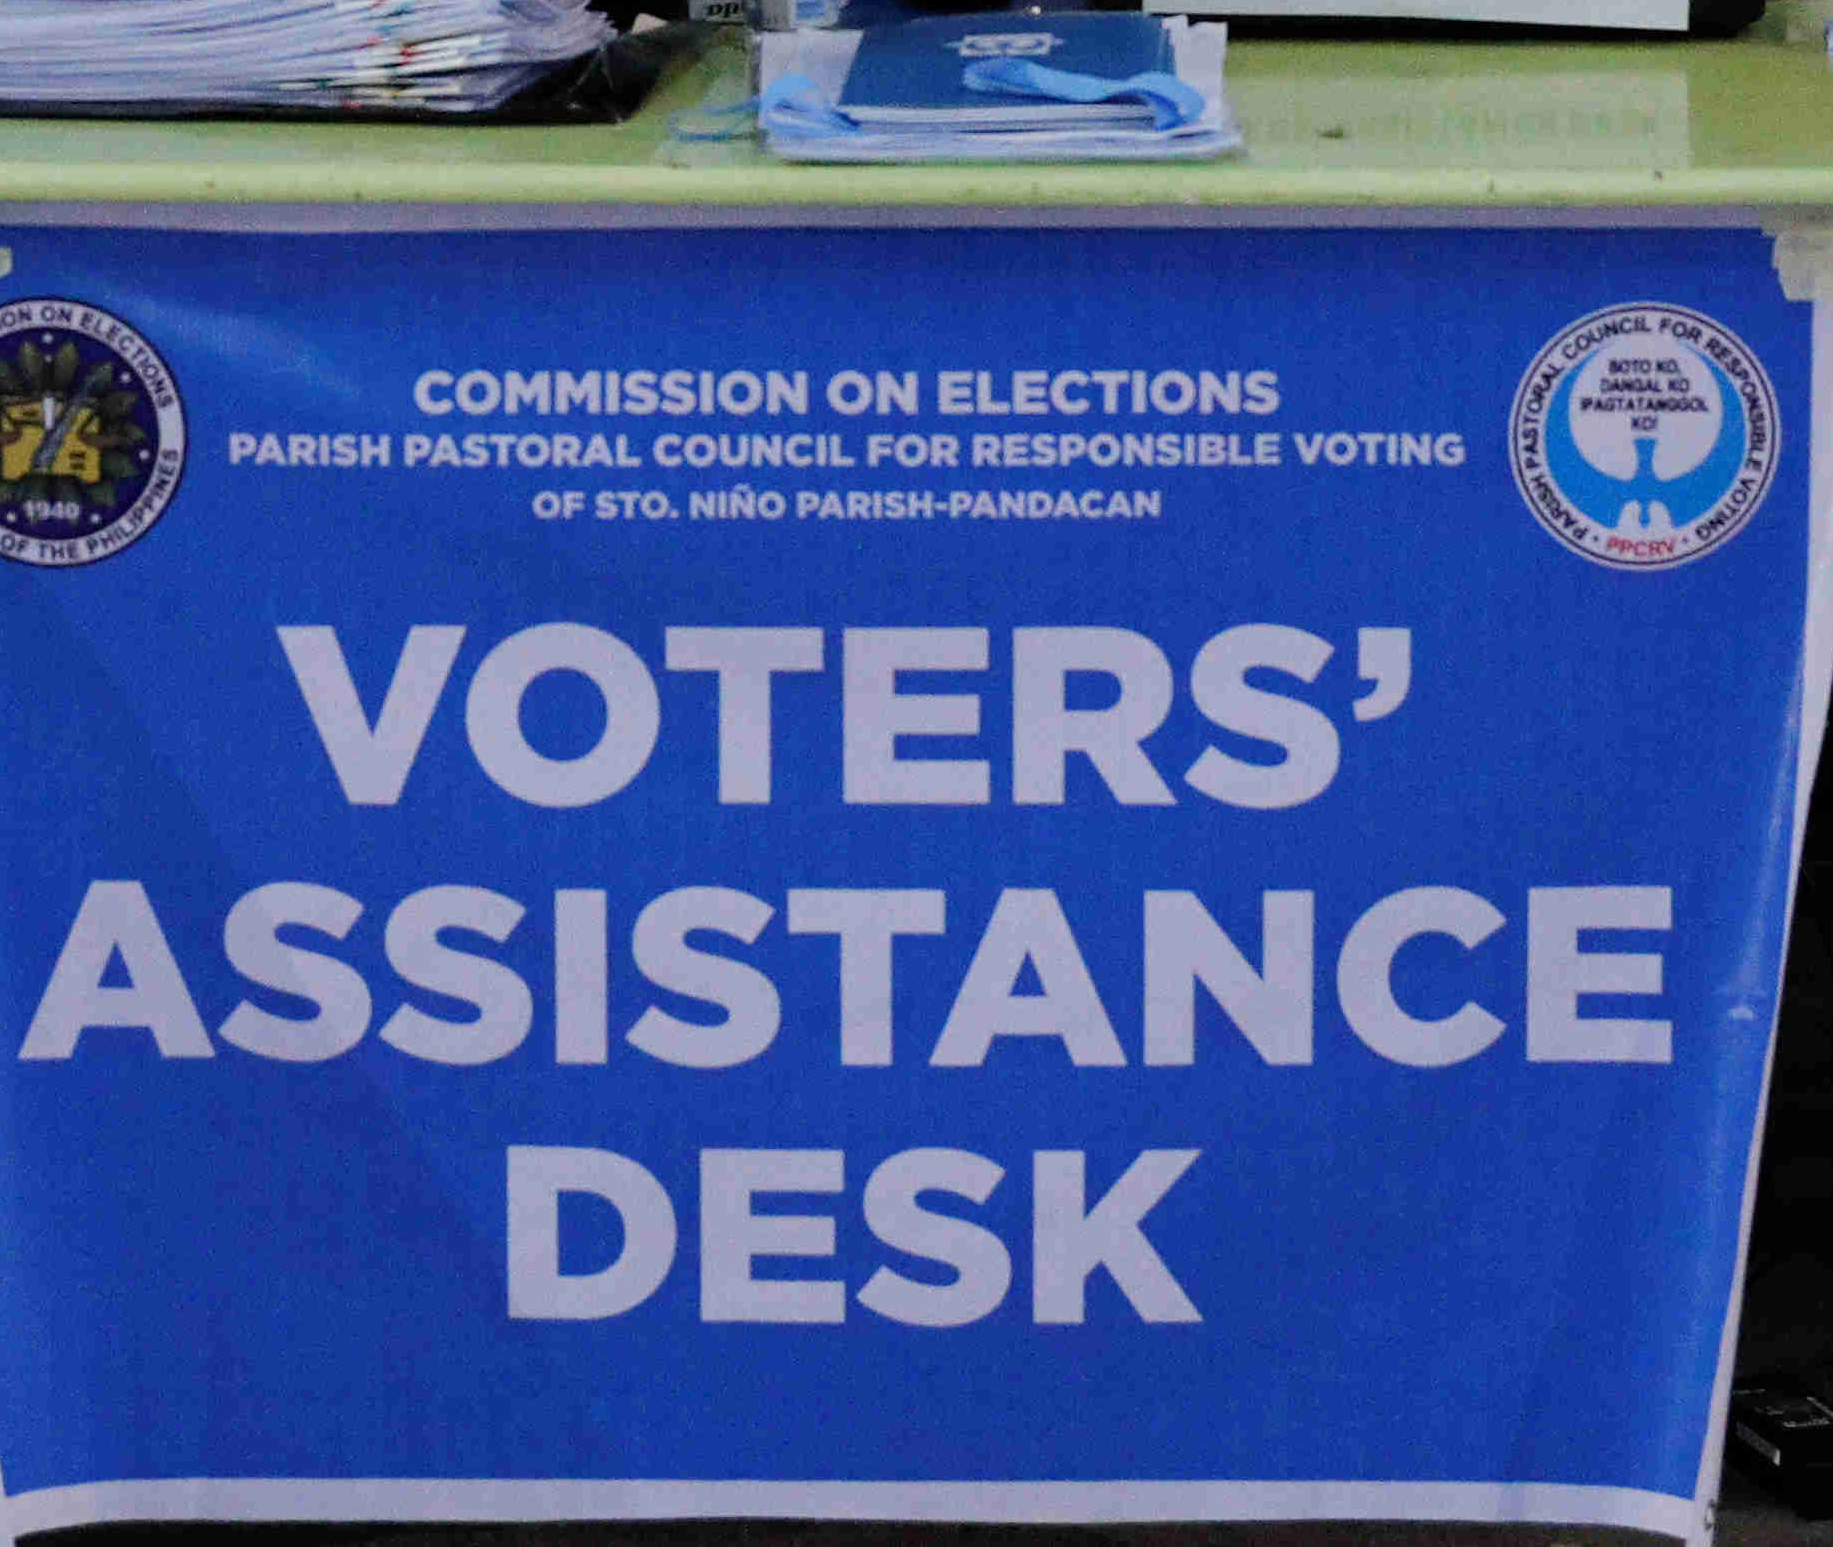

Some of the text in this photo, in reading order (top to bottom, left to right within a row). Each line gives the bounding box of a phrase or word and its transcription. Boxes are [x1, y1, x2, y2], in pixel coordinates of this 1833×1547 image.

[40, 306, 72, 322] ON
[79, 311, 174, 407] ELECTIONS
[1609, 359, 1652, 375] BOTO
[413, 369, 1282, 415] COMMISSION ON ELECTIONS
[1600, 378, 1690, 393] DANGAL KO
[228, 433, 1466, 468] PARISH PASTORAL COUNCIL FOR RESPONSIBLE VOTING
[1522, 316, 1767, 541] PARISH PASTORAL COUNCIL FOR RESPONSIBLE VOTING
[0, 534, 30, 553] OF
[39, 543, 80, 559] THE
[86, 449, 179, 554] PHILIPPINES
[23, 499, 81, 522] 1940
[532, 483, 1161, 520] OF STO. NIÑO PARISH-PANDACAN
[1607, 536, 1678, 557] PPCRV
[276, 621, 1414, 808] VOTERS’
[18, 880, 1674, 1069] ASSISTANCE
[505, 1145, 1204, 1327] DESK
